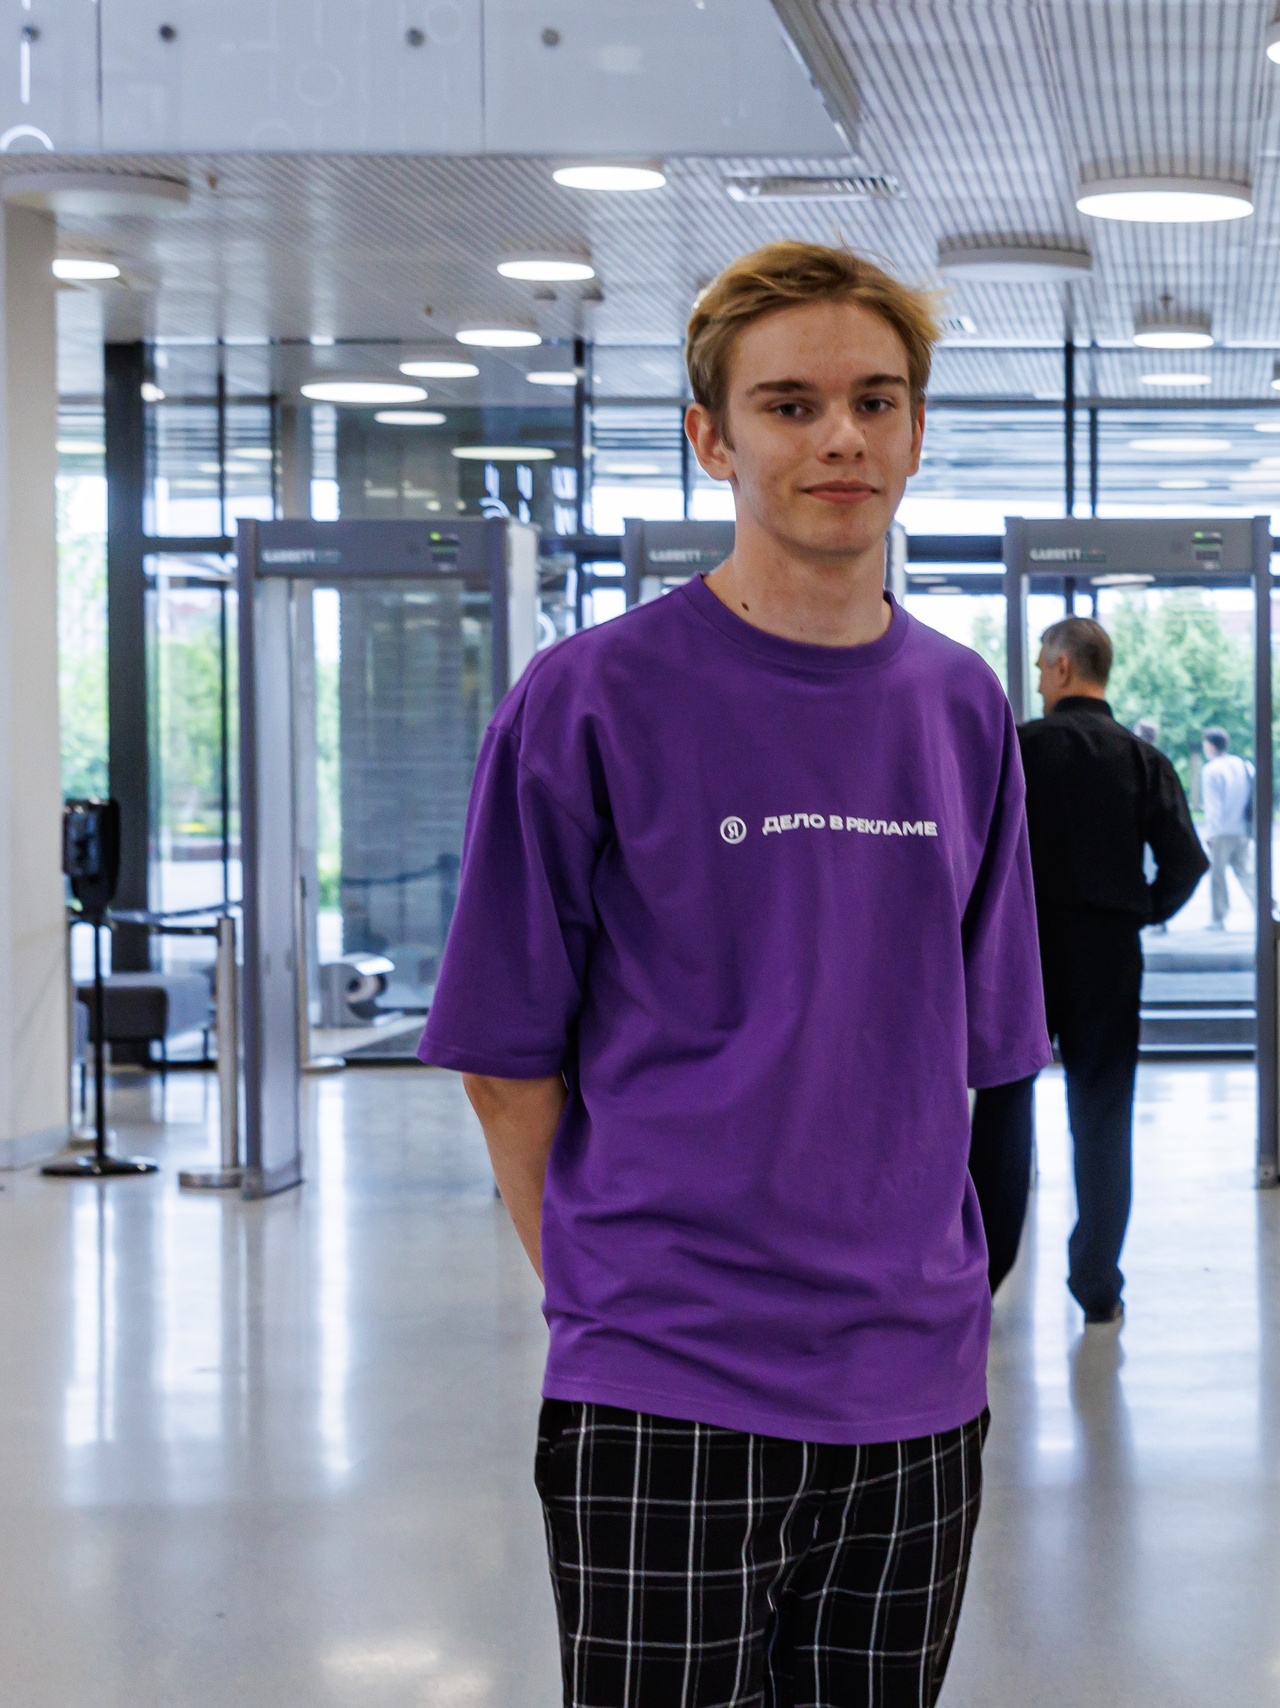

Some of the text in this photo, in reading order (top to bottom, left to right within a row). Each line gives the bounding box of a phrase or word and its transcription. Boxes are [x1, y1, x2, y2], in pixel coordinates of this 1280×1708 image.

[762, 813, 826, 836] ДЕЛО
[829, 814, 844, 831] В
[846, 815, 938, 837] РЕКЛАМЕ
